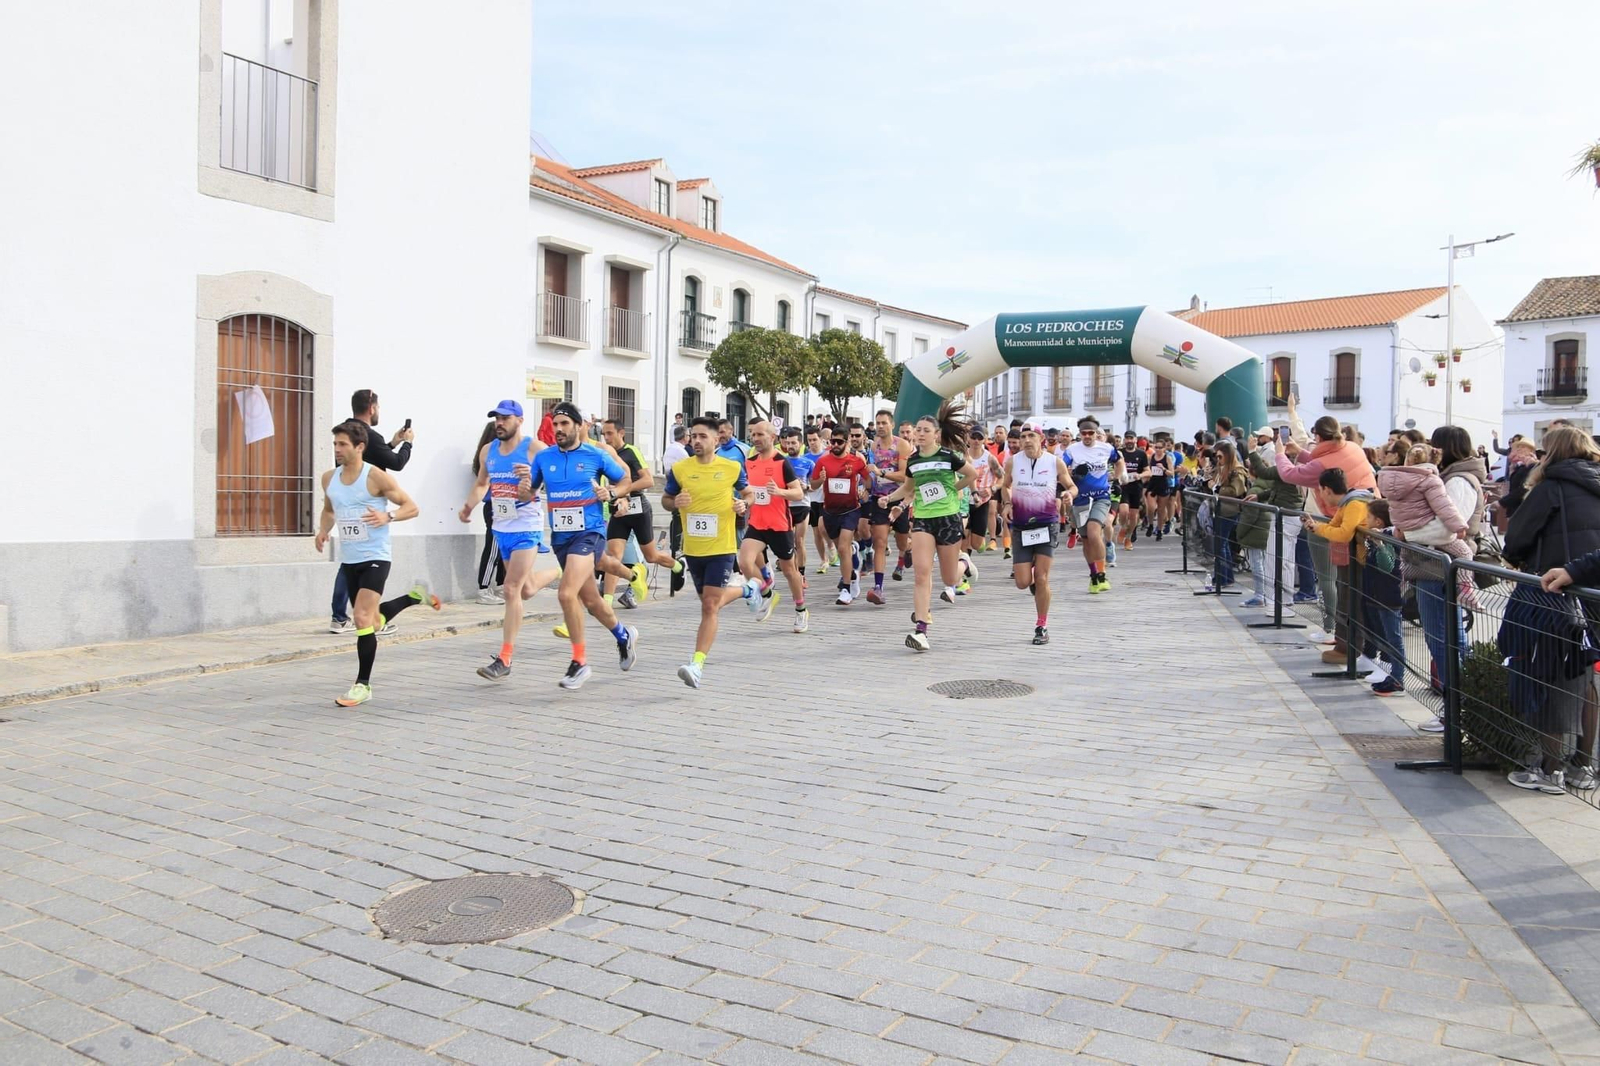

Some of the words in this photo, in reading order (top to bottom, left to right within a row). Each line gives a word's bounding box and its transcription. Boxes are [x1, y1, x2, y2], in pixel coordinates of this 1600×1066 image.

[1005, 323, 1032, 334] LOS
[1036, 319, 1124, 334] PEDROCHES
[1004, 337, 1064, 347] Mancomunidad
[1065, 337, 1075, 346] de
[1077, 336, 1122, 347] Municipios
[924, 487, 939, 497] 130
[497, 504, 508, 514] 79
[560, 515, 573, 525] 78
[695, 520, 708, 530] 83
[342, 525, 360, 535] 176
